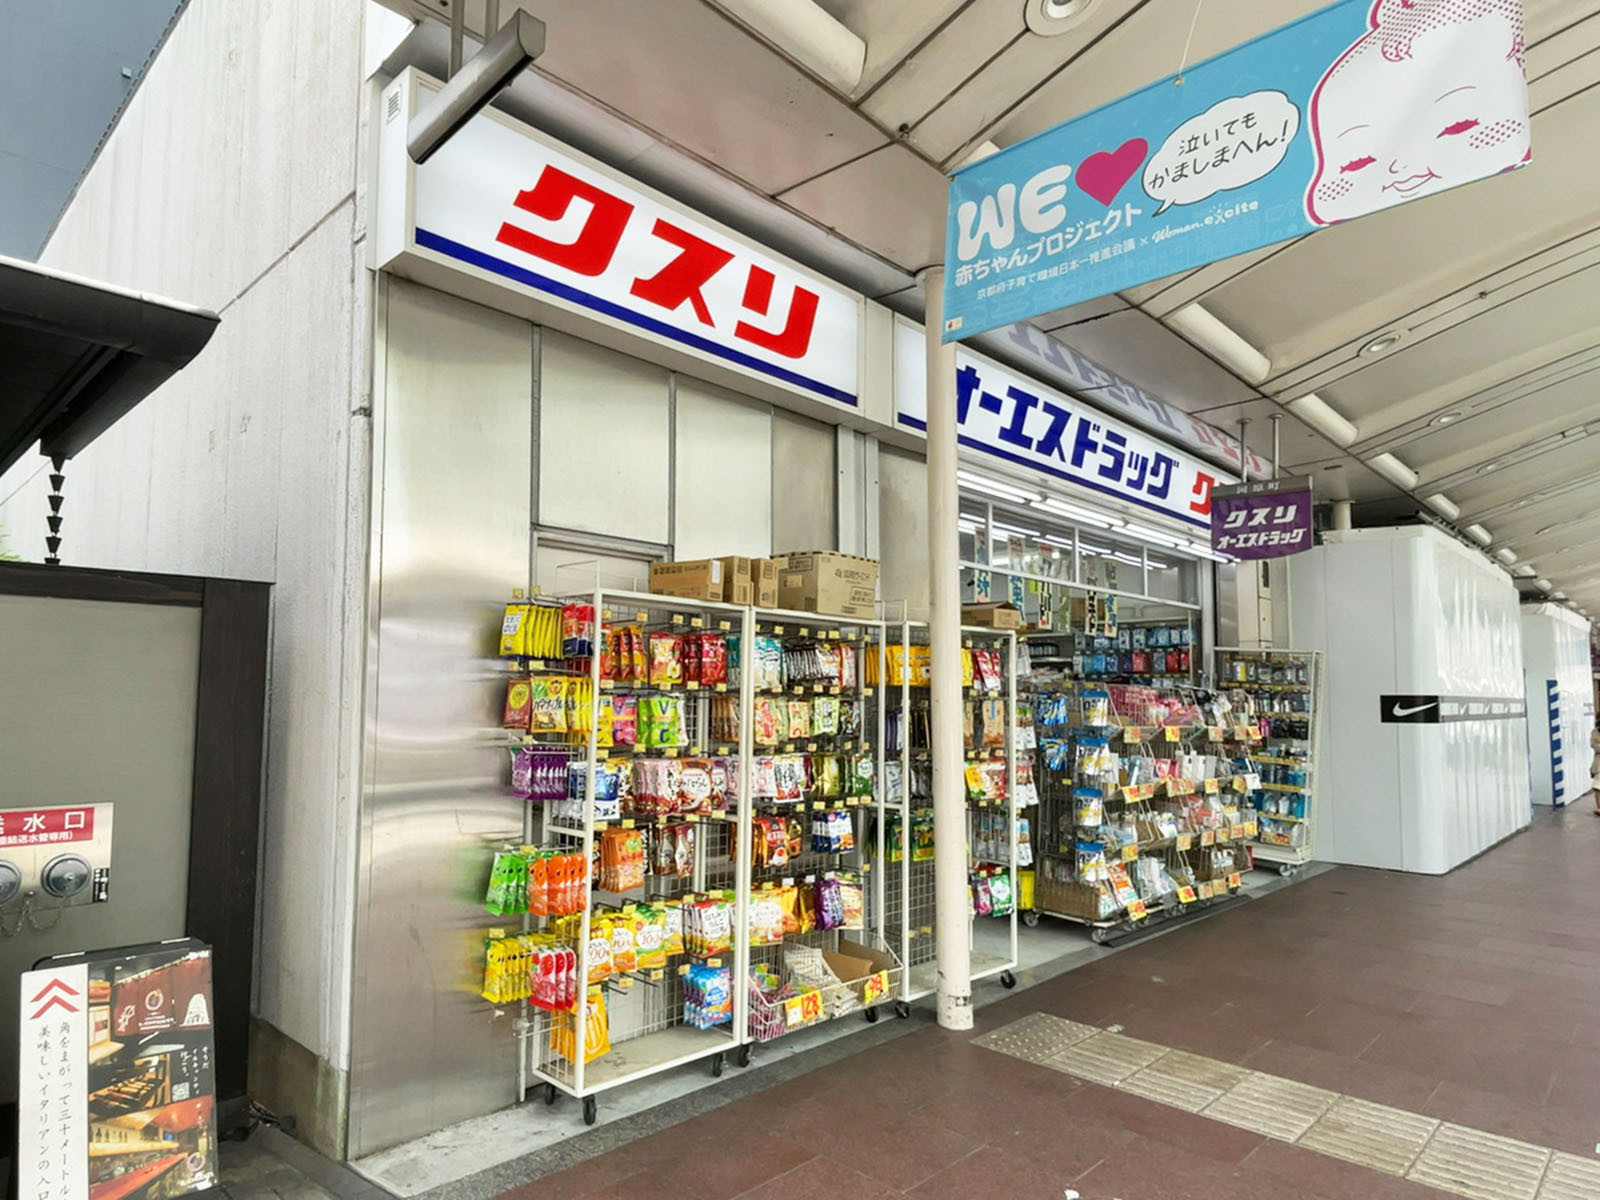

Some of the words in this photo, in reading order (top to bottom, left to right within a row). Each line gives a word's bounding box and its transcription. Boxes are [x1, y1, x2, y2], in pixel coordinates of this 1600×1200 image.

[1148, 119, 1289, 190] かましまへん!
[1179, 112, 1257, 157] 泣いても
[954, 202, 1143, 287] 赤ちゃんプロジェクト
[957, 164, 1072, 262] WE
[495, 164, 820, 360] クスリ
[1216, 528, 1308, 550] オーエスドラッグ
[1223, 504, 1298, 530] クスリ
[0, 811, 86, 835] 水口
[58, 1022, 72, 1200] 角をまがって三十メートル
